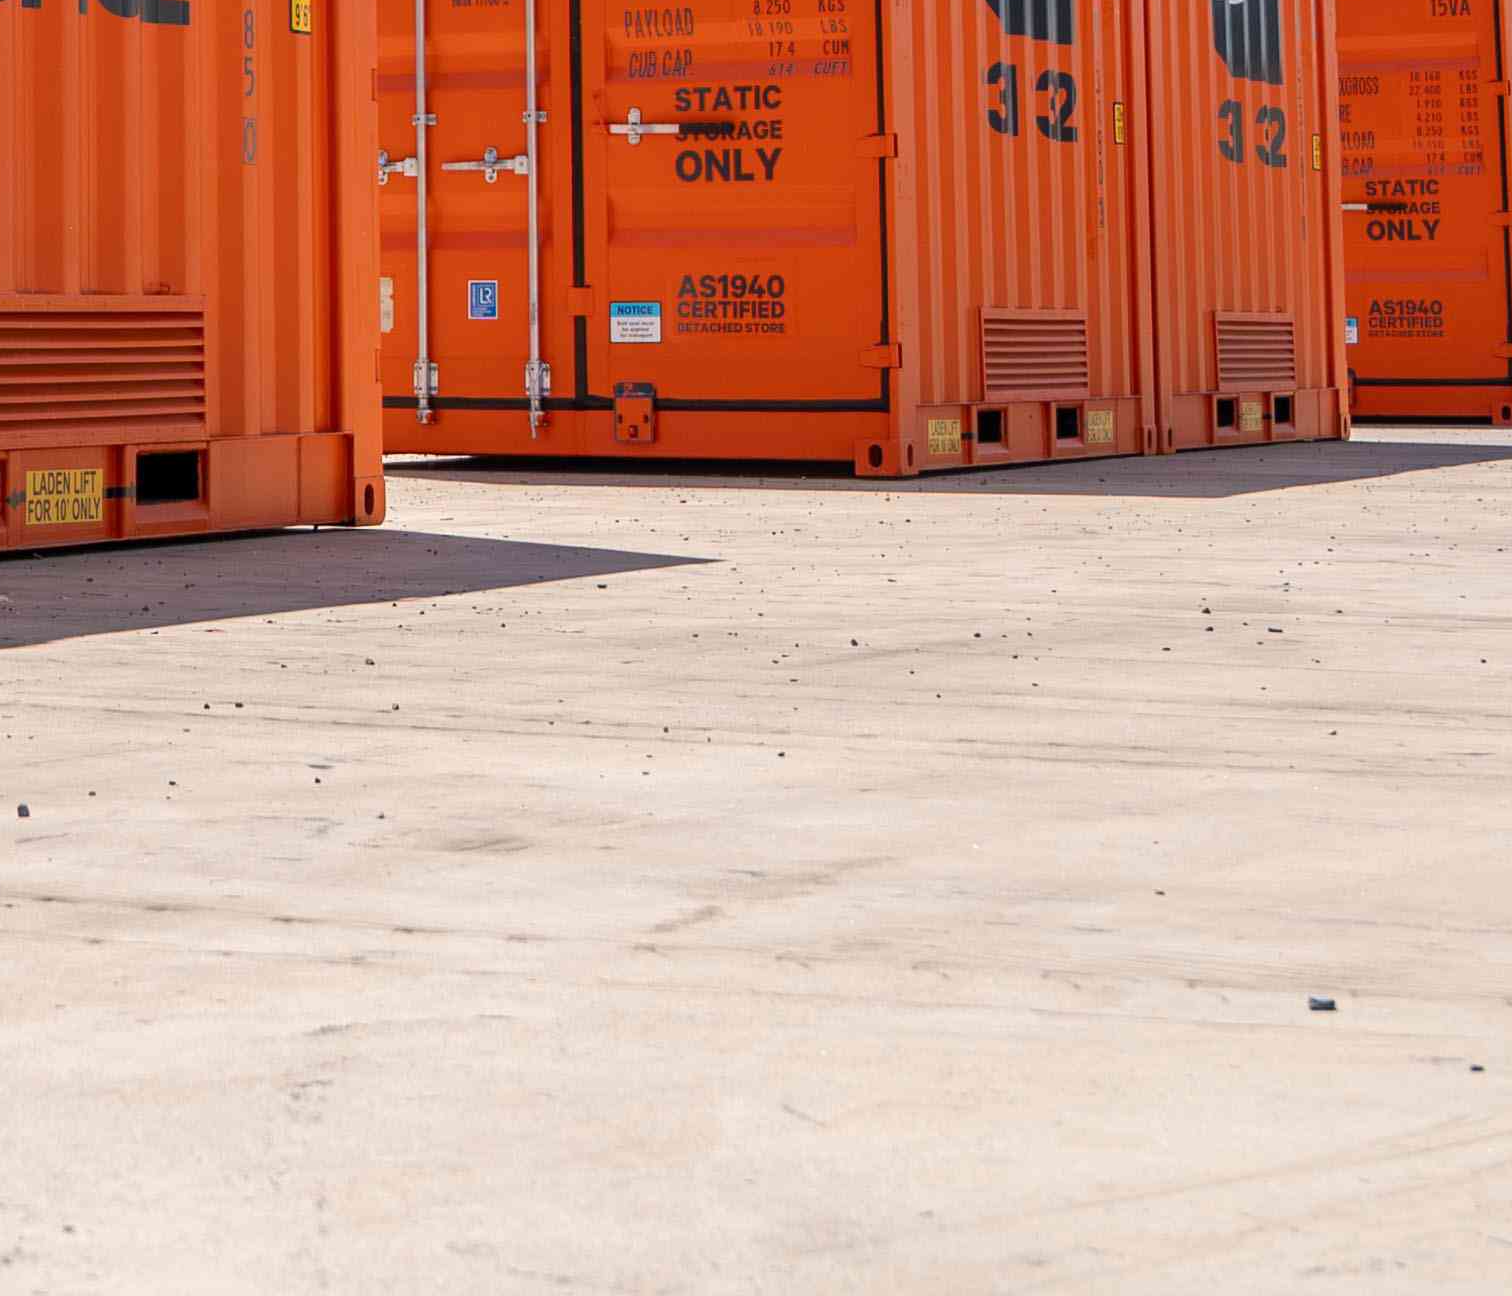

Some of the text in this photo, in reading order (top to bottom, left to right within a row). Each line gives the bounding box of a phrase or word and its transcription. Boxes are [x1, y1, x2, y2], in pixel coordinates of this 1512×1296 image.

[624, 7, 694, 39] PAYLOAD
[821, 19, 848, 34] LBS
[823, 40, 849, 55] CUM
[814, 61, 849, 75] CUFT
[675, 85, 781, 112] STATIC
[676, 148, 782, 182] ONLY
[1365, 179, 1439, 196] STATIC
[1366, 219, 1440, 241] ONLY
[678, 274, 785, 298] AS1940
[617, 305, 653, 315] NOTICE
[677, 301, 784, 319] CERTIFIED
[1370, 299, 1443, 316] AS1940
[1368, 317, 1443, 328] CERTIFIED
[33, 471, 96, 496] LADEN LIFT
[27, 499, 51, 522] FOR
[73, 498, 100, 520] ONLY
